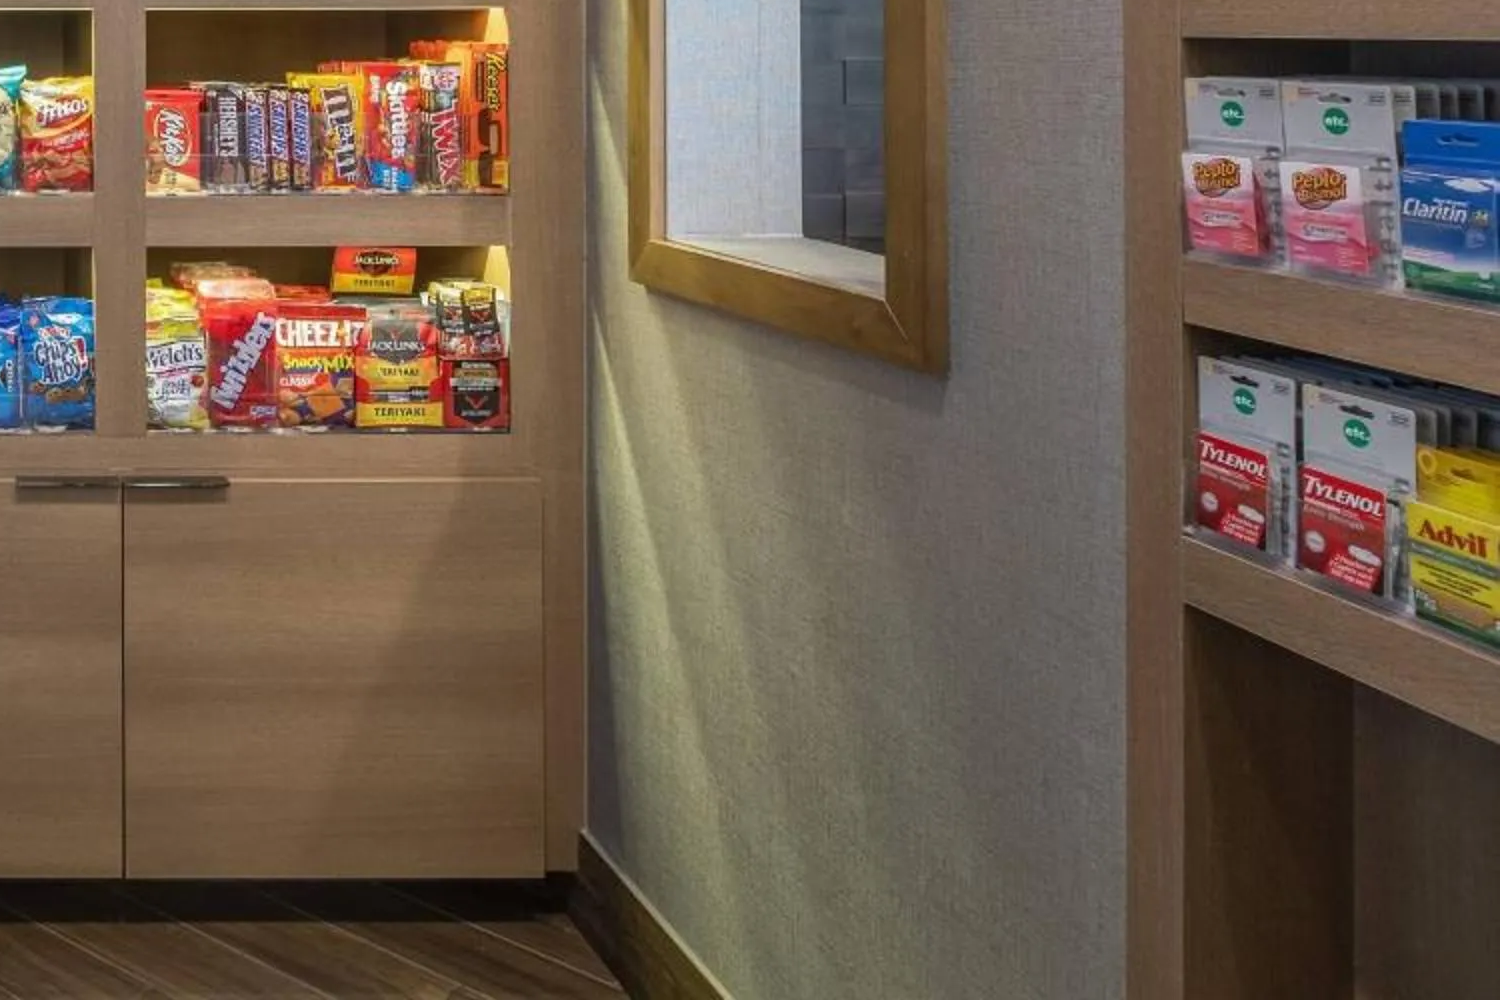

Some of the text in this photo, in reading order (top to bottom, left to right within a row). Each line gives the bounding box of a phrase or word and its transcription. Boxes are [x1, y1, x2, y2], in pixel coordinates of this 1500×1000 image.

[218, 97, 239, 157] HERSHEY'S
[430, 107, 460, 187] TWIX
[1293, 172, 1343, 189] Pepto
[1402, 197, 1468, 224] Claritin
[148, 343, 203, 368] Welch's
[373, 406, 427, 417] TERIYAKI
[1200, 440, 1266, 479] TYLENOL
[1303, 473, 1383, 517] TYLENOL
[1418, 519, 1488, 558] Advil
